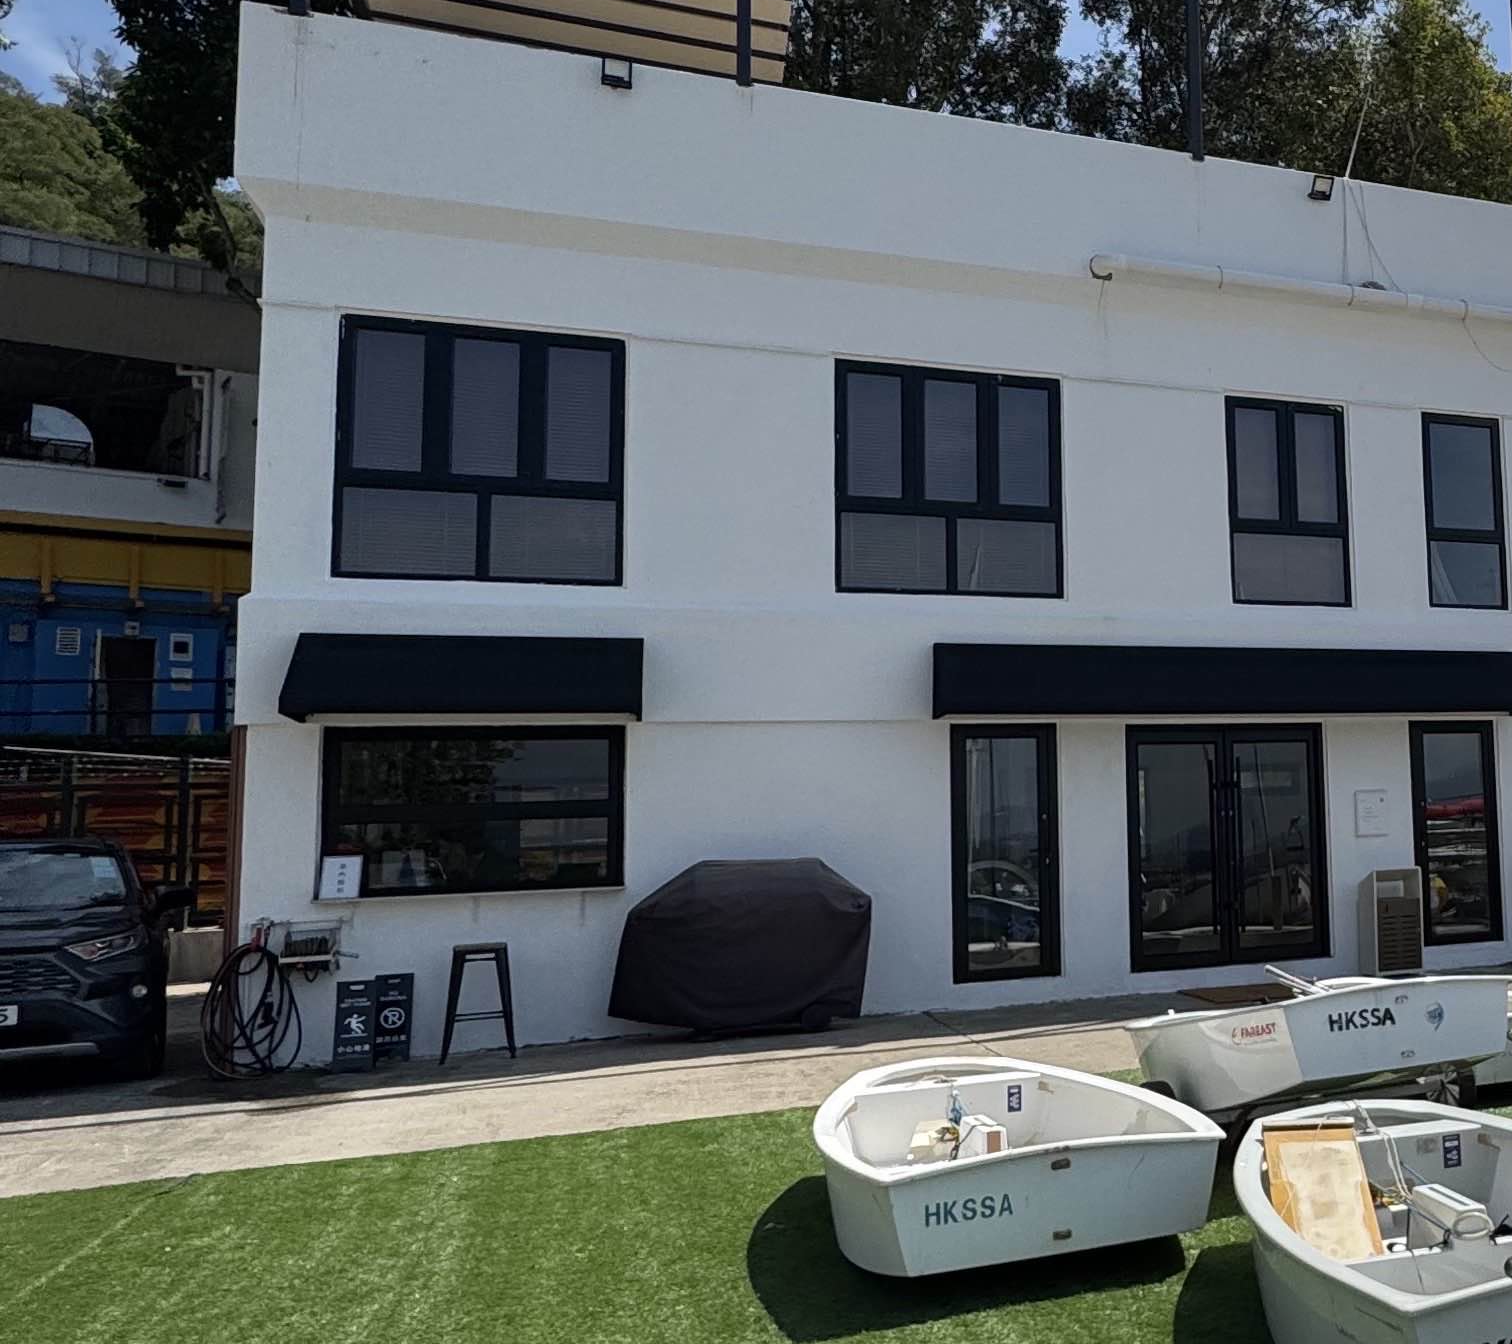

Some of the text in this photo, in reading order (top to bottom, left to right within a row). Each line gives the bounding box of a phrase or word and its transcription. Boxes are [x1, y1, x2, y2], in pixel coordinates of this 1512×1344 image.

[1240, 1022, 1277, 1038] FAREAST
[1328, 1008, 1396, 1032] HKSSA
[924, 1193, 1013, 1227] HKSSA
